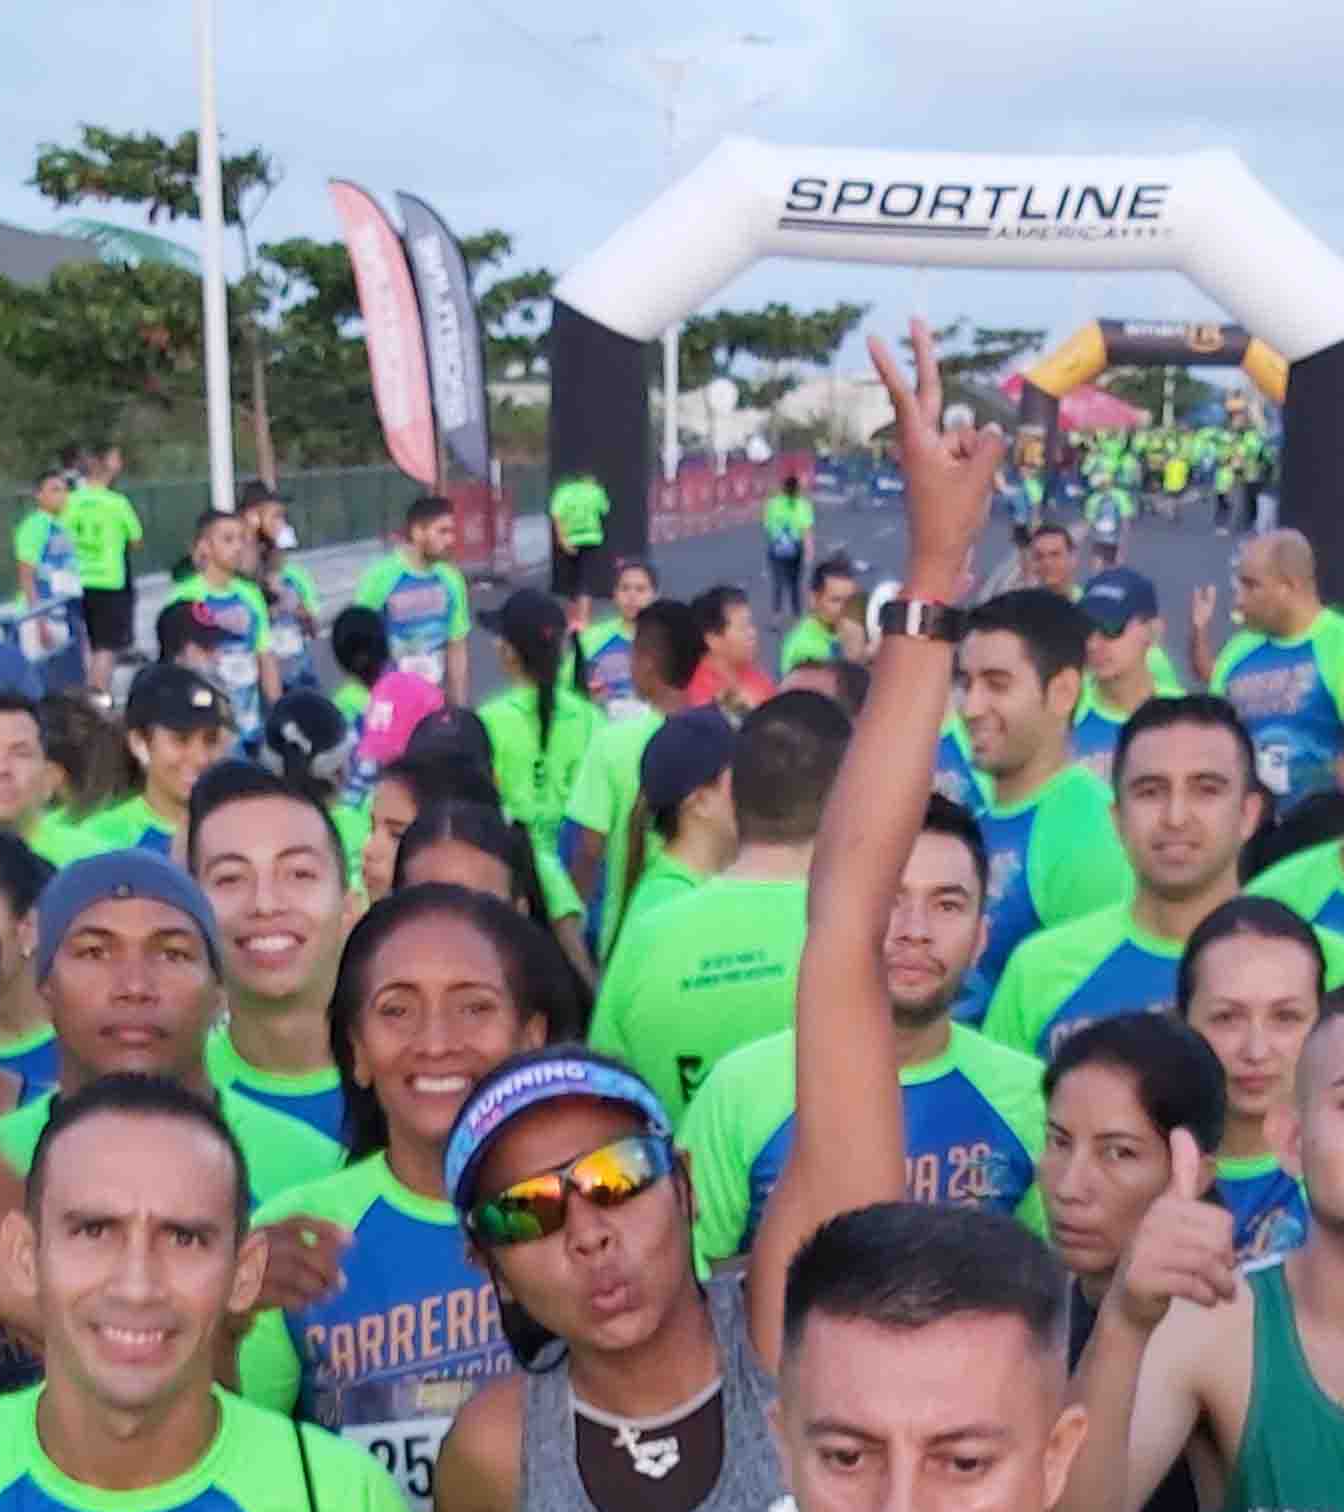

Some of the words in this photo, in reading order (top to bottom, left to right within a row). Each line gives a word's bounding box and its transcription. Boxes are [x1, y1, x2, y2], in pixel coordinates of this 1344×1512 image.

[784, 177, 1173, 222] SPORTLINE
[993, 225, 1124, 243] AMERICA
[469, 1058, 588, 1130] RUNNING
